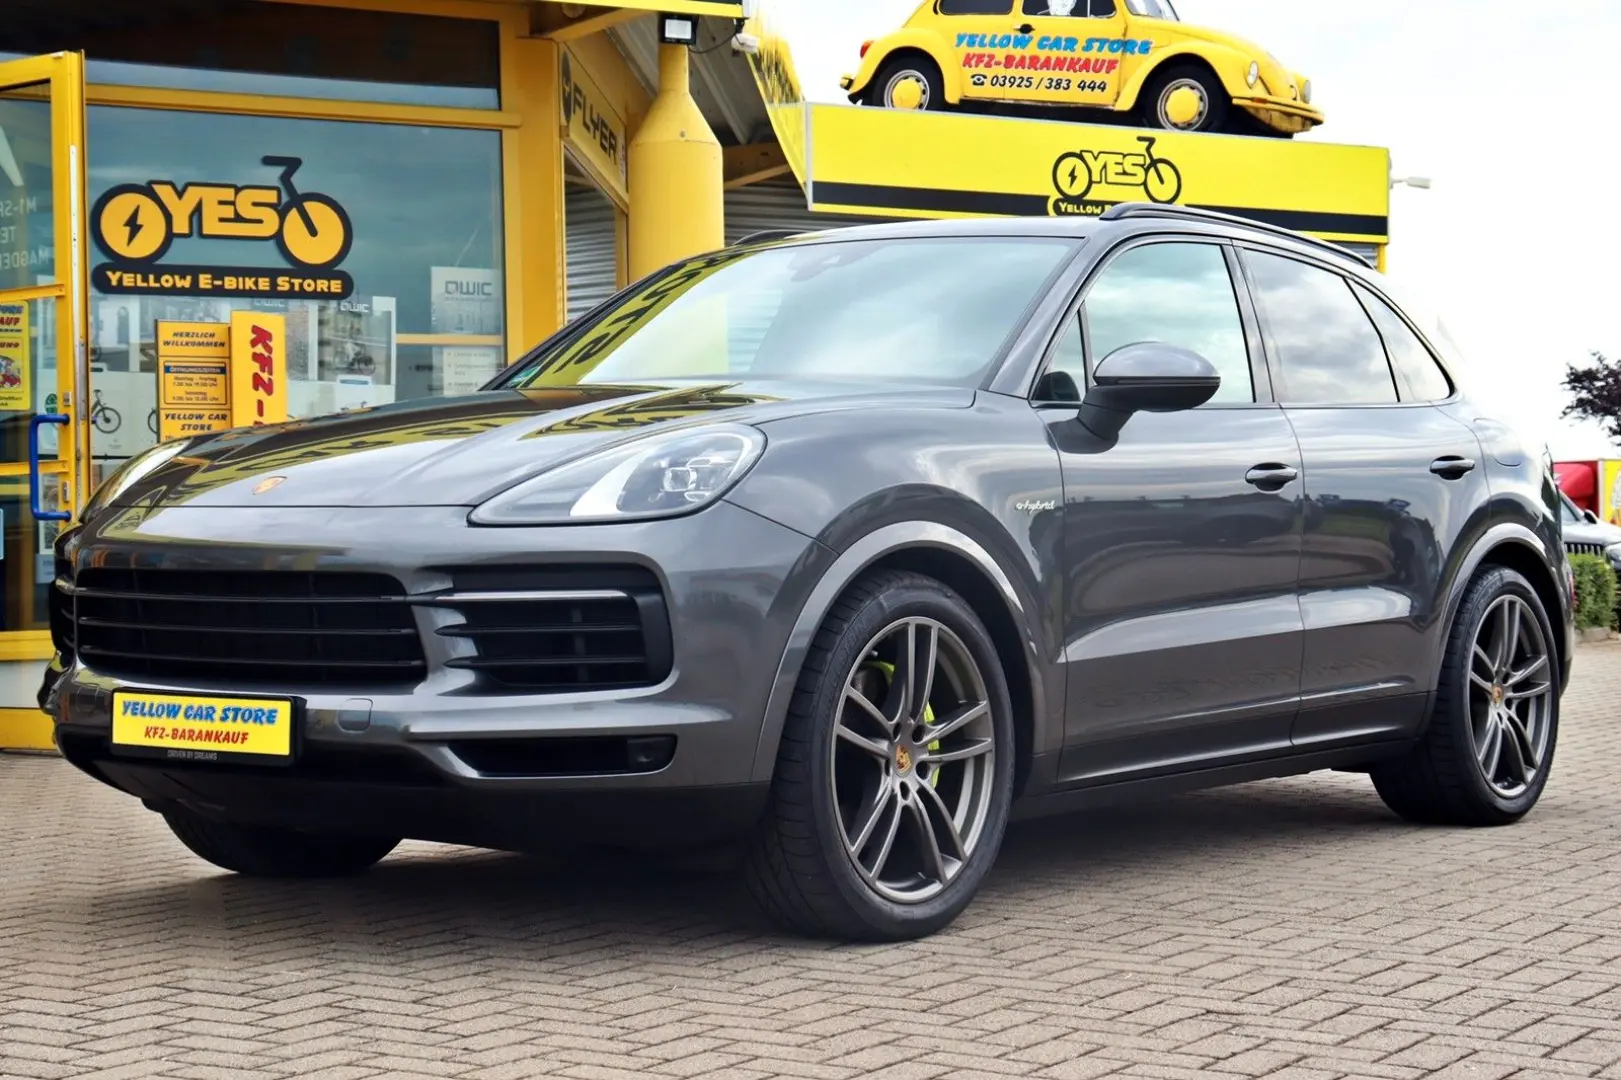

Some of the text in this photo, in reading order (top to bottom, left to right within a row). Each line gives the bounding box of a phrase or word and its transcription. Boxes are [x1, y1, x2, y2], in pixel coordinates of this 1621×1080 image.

[955, 33, 1152, 55] YELLOW CAR STORE
[962, 52, 1119, 74] KFZ-BARANKAUF
[990, 75, 1033, 89] 03925
[1045, 78, 1072, 91] 383
[1077, 79, 1107, 92] 444
[573, 81, 617, 165] FLYER
[1080, 150, 1146, 186] YES
[150, 182, 281, 239] YES
[105, 271, 193, 289] YELLOW
[445, 281, 492, 296] QWIC
[163, 340, 225, 348] WILLKOMMEN
[172, 331, 216, 339] HERZLICH
[165, 413, 228, 422] YELLOW CAR
[122, 700, 278, 725] YELLOW CAR STORE
[144, 726, 249, 745] KFZ-BARANKAUF
[194, 751, 218, 760] DREAMS
